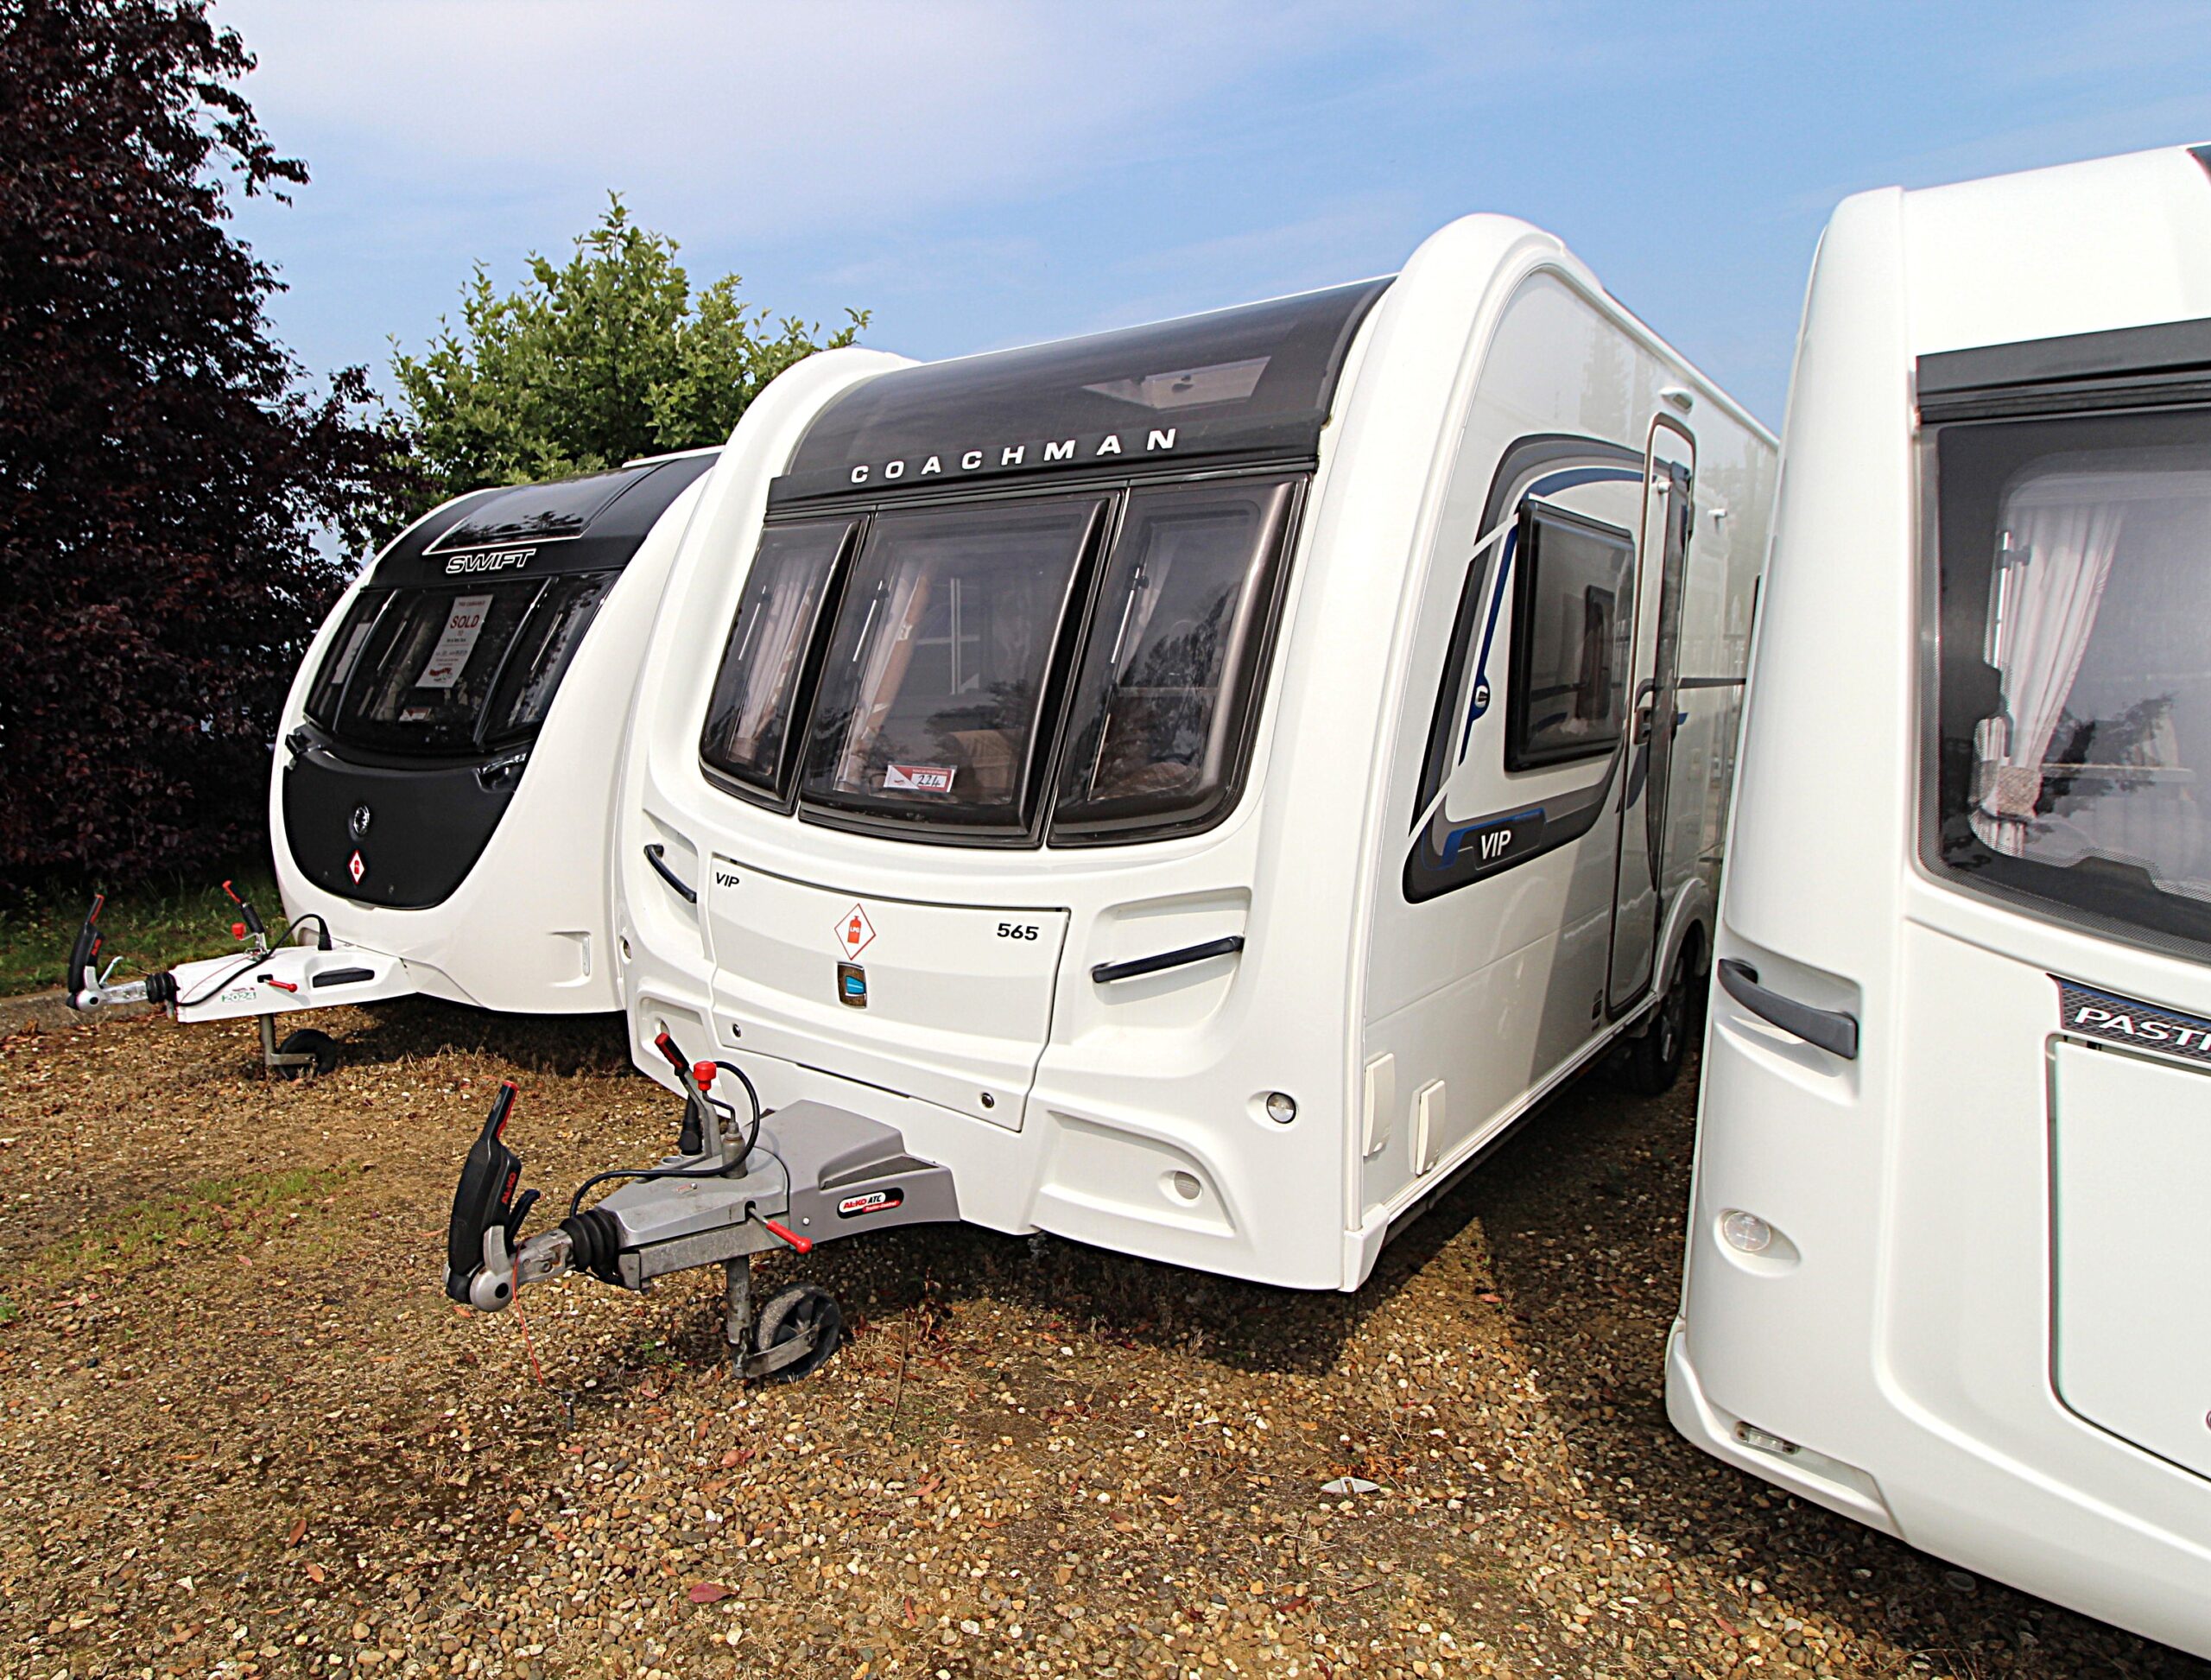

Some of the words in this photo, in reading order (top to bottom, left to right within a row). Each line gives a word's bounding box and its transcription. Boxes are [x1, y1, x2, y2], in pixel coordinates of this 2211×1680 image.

[851, 428, 1176, 484] COACHMAN
[446, 548, 536, 574] SWIFT
[450, 614, 480, 629] SOLD
[1481, 829, 1511, 860] VIP
[716, 872, 740, 888] VIP
[997, 922, 1039, 941] 565
[867, 1195, 882, 1204] ATC
